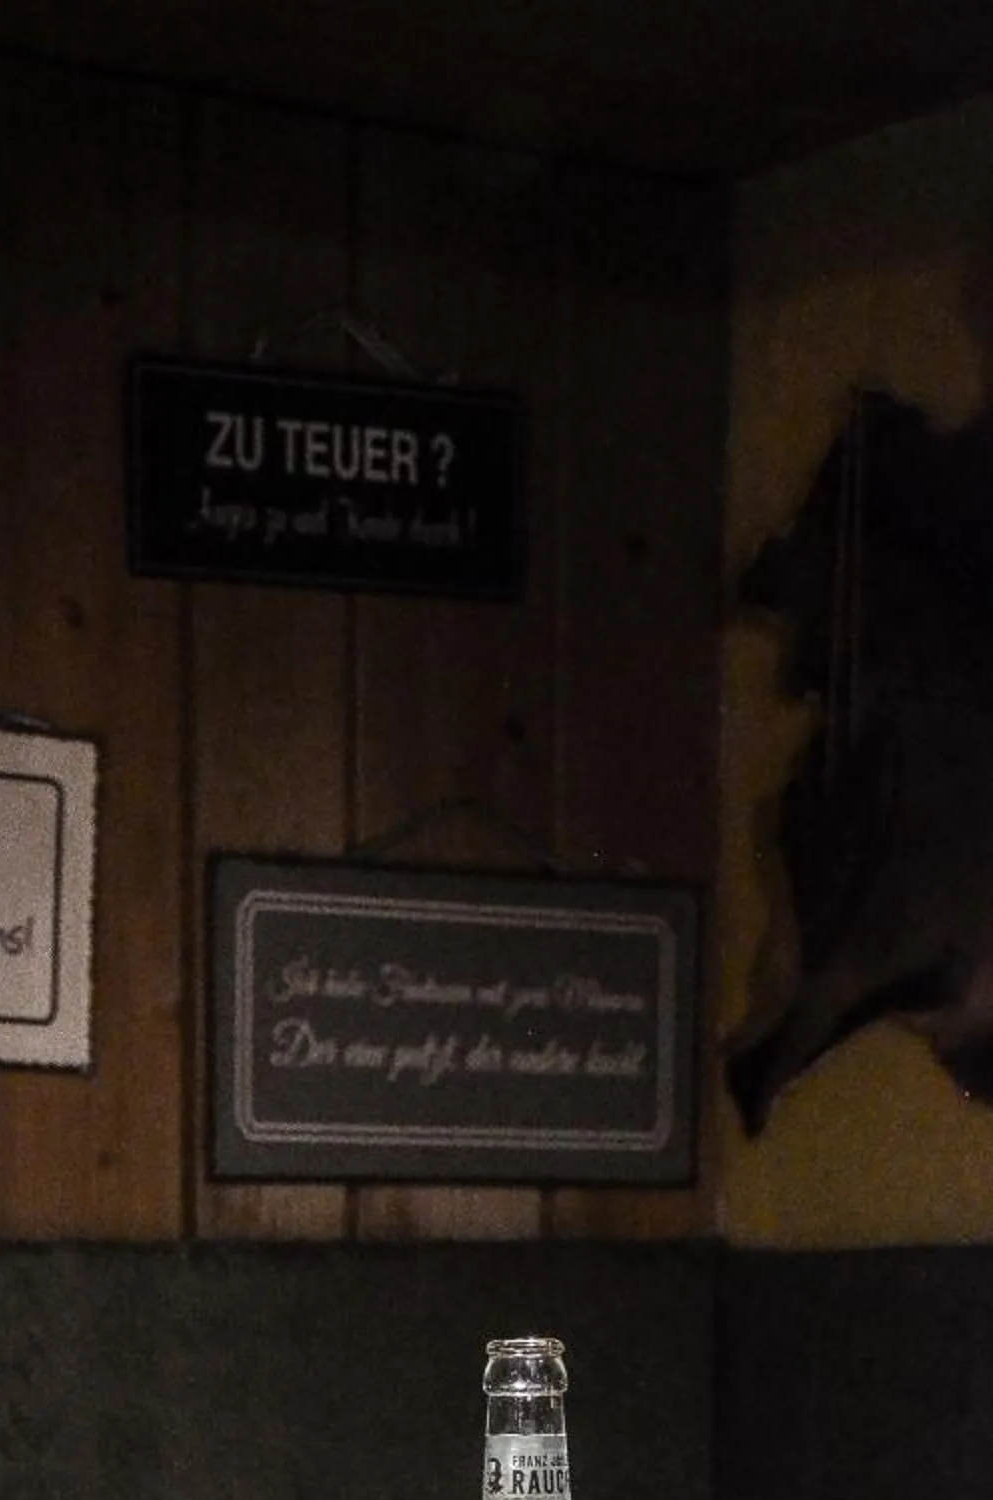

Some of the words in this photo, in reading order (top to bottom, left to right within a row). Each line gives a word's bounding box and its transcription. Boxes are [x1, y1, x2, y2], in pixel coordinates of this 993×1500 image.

[206, 410, 265, 472] ZU
[277, 419, 419, 487] TEUER
[512, 1455, 547, 1468] FRANZ
